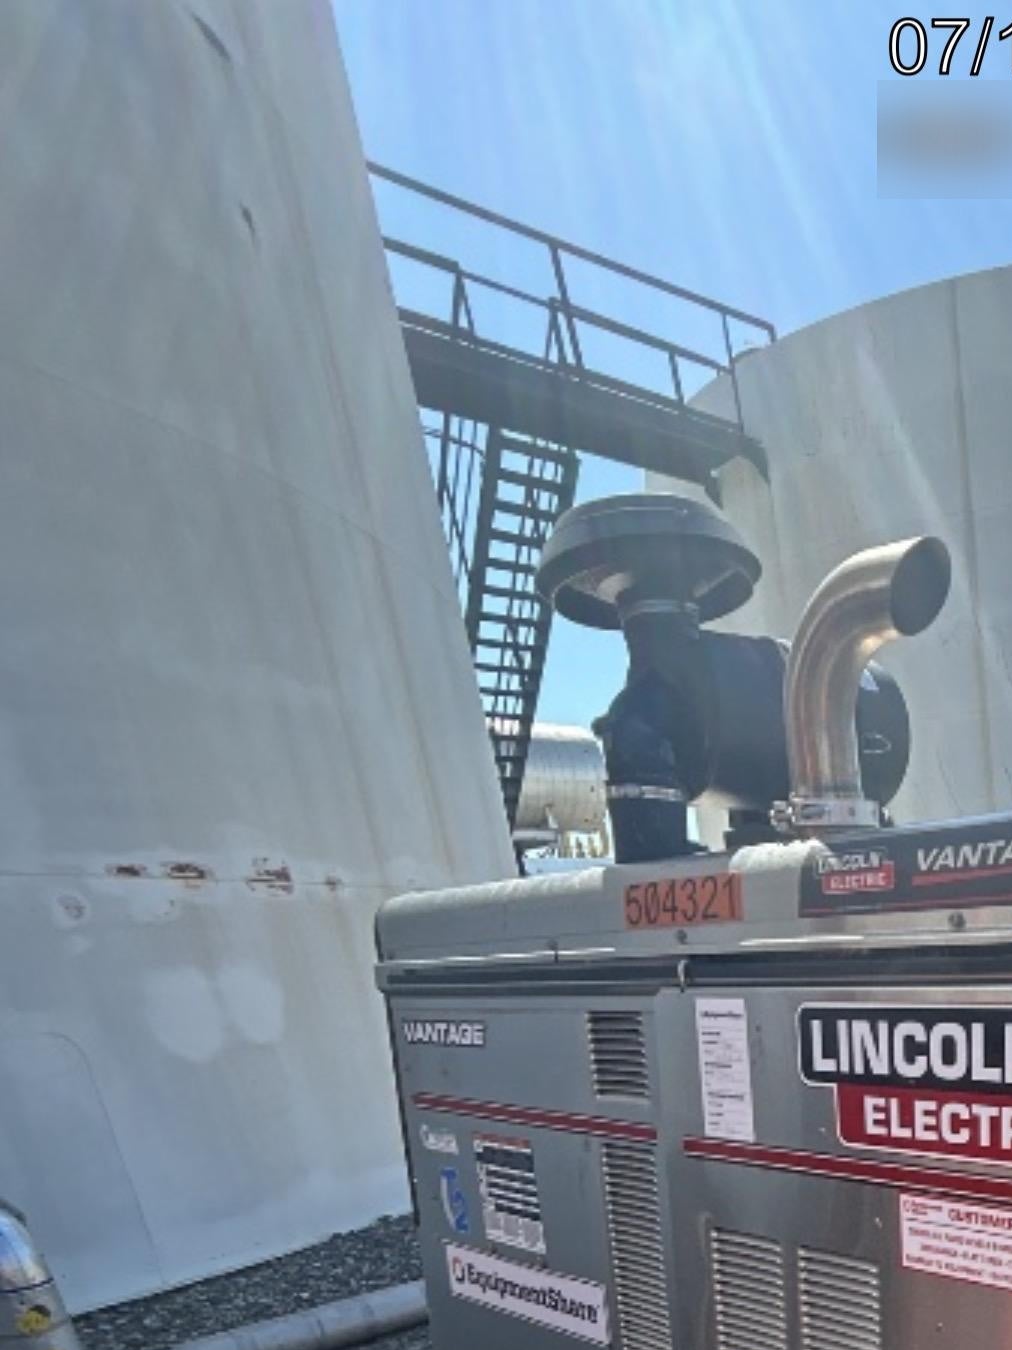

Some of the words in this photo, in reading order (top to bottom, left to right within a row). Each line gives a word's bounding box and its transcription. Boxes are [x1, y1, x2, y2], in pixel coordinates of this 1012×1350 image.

[625, 873, 736, 926] 504321
[404, 1022, 484, 1045] VANTAGE
[467, 1263, 599, 1323] EquipmentShare
